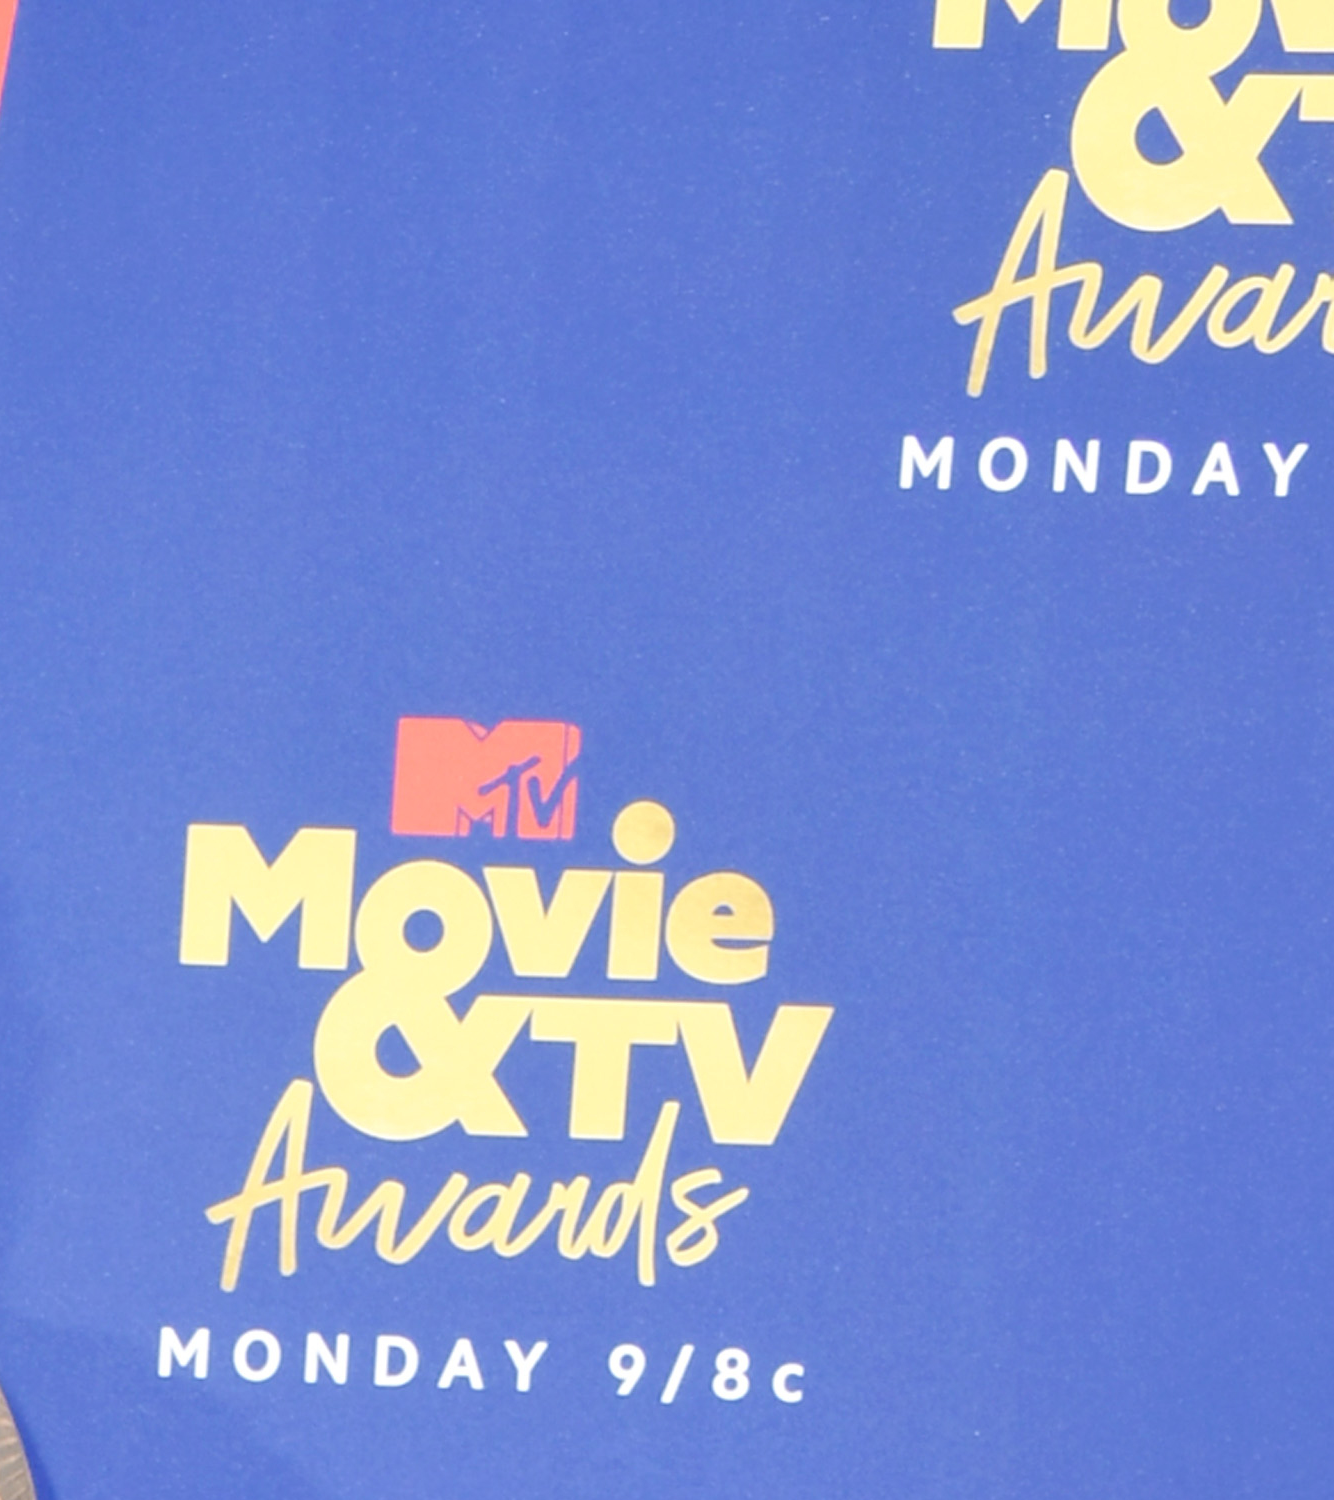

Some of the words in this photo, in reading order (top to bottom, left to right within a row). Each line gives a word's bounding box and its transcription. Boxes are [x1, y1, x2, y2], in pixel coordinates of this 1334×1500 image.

[899, 435, 1309, 497] MONDAY
[391, 716, 581, 840] MTV
[179, 800, 774, 985] Movie
[205, 1079, 749, 1292] Awards
[157, 1325, 548, 1393] MONDAY
[607, 1342, 805, 1405] 9/8c
